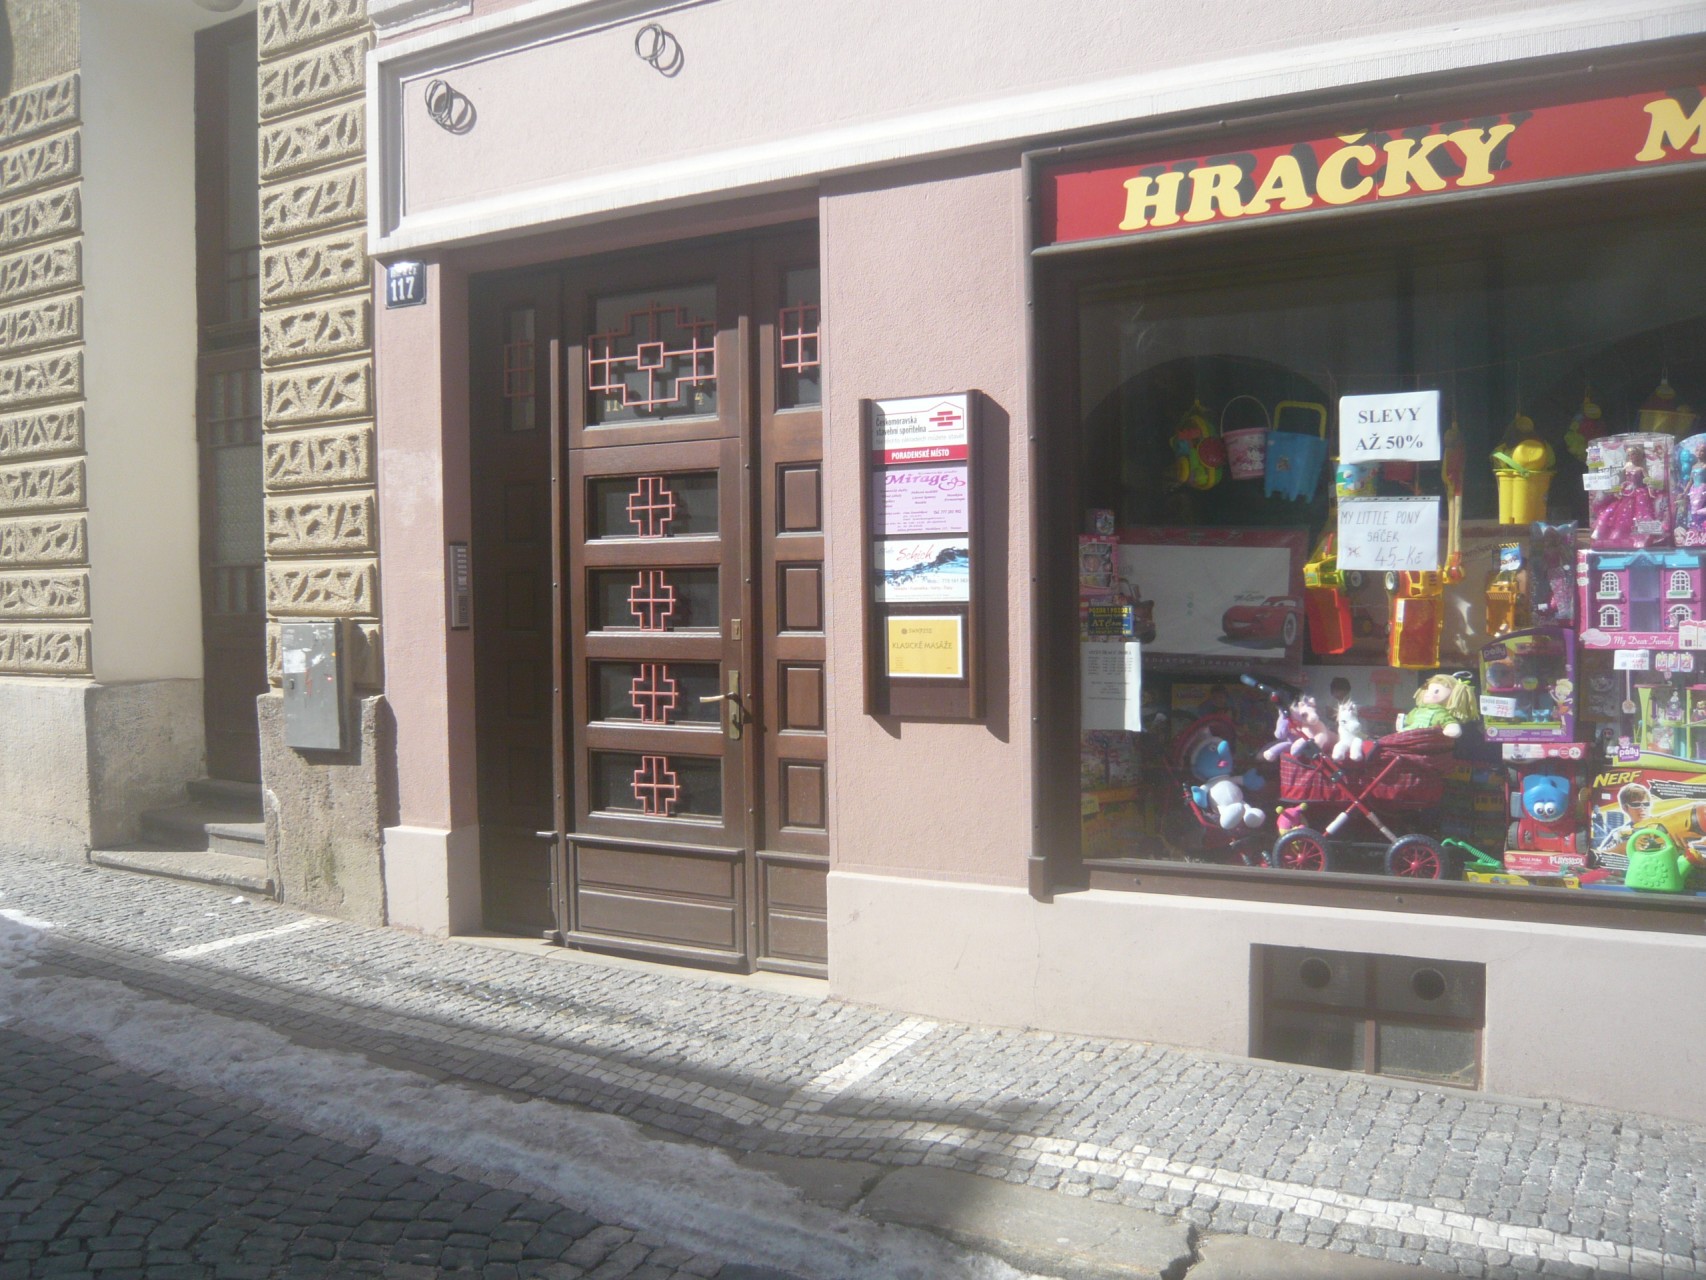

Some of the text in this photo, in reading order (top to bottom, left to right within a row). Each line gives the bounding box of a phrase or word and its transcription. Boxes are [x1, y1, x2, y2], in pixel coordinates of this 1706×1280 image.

[1118, 123, 1516, 231] HRAČKY
[391, 276, 415, 302] 117
[1358, 408, 1420, 424] SLEVY
[1356, 433, 1423, 450] AŽ 50%
[891, 448, 950, 460] PORADENSKÉ MÍSTO
[885, 474, 949, 486] Mirage
[1340, 510, 1421, 526] MY LITTLE PONY
[1367, 528, 1399, 543] SÁČEK
[892, 640, 953, 649] KLASICKÉ MASÁŽE
[1613, 635, 1675, 646] My Dear Family
[1619, 746, 1640, 758] polly
[1593, 770, 1642, 788] NERF
[1549, 856, 1584, 866] PLAYSKOOL
